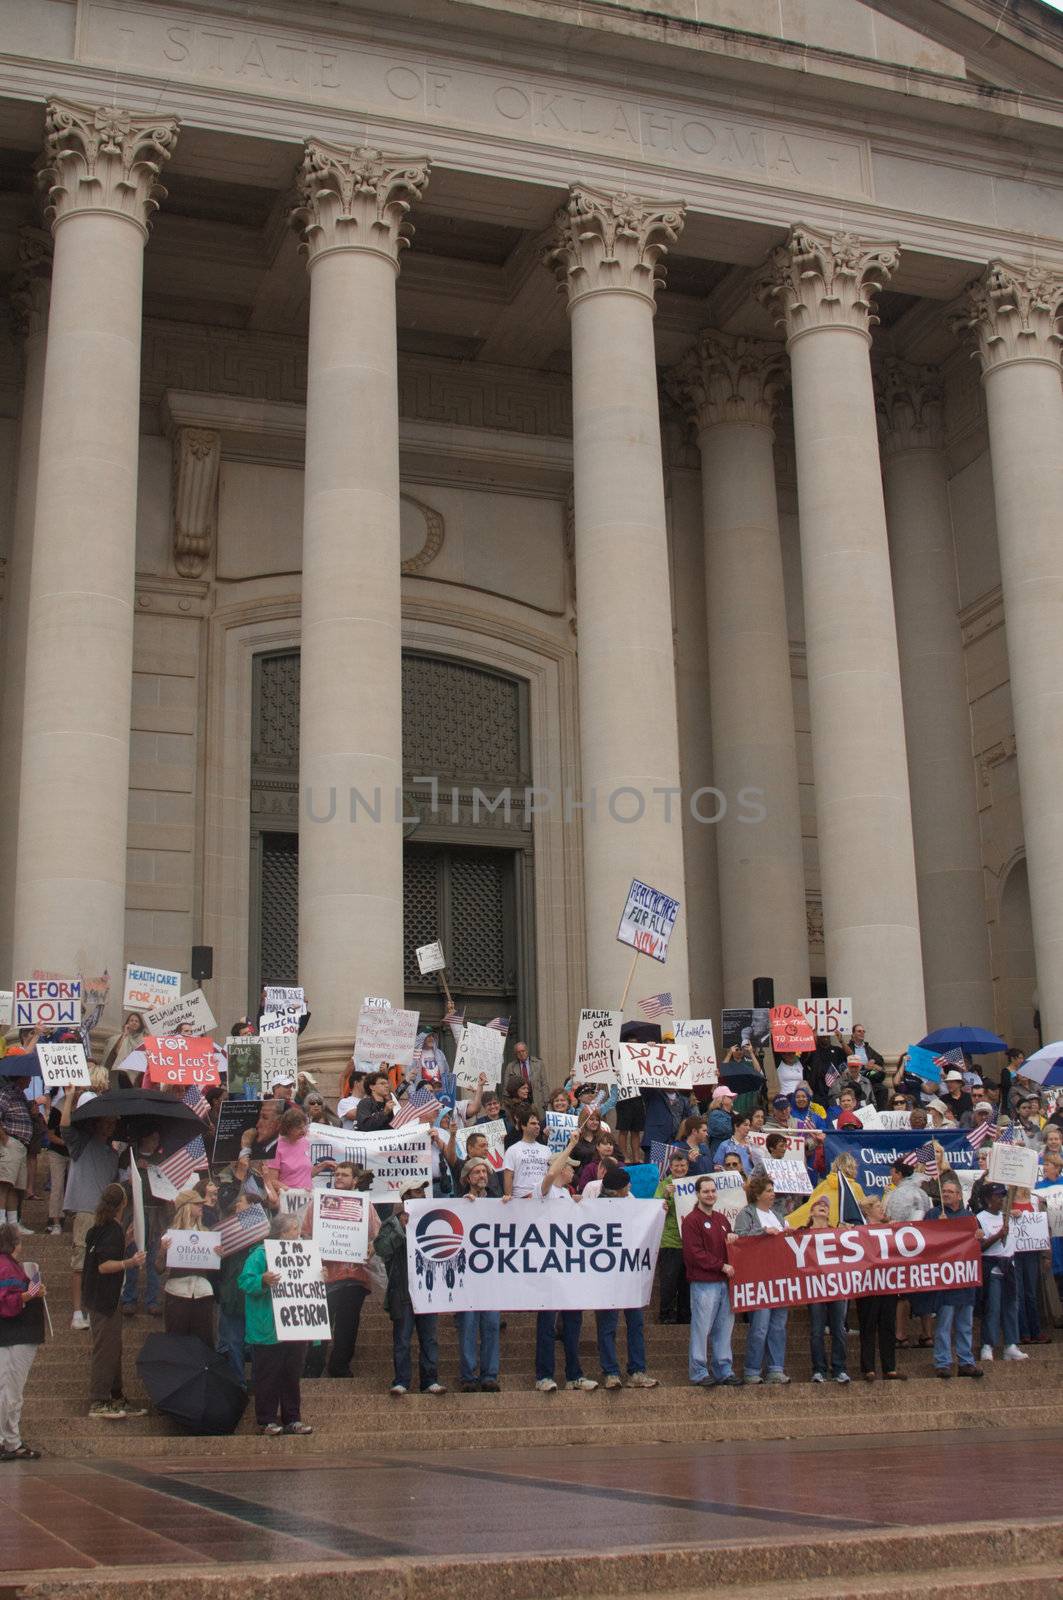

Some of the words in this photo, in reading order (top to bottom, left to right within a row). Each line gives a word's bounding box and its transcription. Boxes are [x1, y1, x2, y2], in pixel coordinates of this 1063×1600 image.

[162, 26, 342, 90] STATE
[384, 65, 452, 110] OF
[492, 84, 802, 176] OKLAHOMA
[628, 906, 649, 926] FOR
[648, 914, 666, 936] ALL
[128, 969, 156, 982] HEALTH
[156, 973, 178, 987] CARE
[16, 982, 81, 999] REFORM
[128, 990, 150, 1003] FOR
[186, 997, 200, 1008] THE
[368, 997, 388, 1008] FOR
[17, 1002, 75, 1024] NOW
[276, 1006, 296, 1019] NO
[582, 1011, 609, 1020] HEALTH
[774, 1006, 802, 1018] NOW
[260, 1016, 299, 1033] TRICKL
[592, 1018, 613, 1029] CARE
[587, 1031, 593, 1039] IS
[600, 1030, 606, 1038] A
[157, 1037, 188, 1050] FOR
[582, 1038, 611, 1050] BASIC
[269, 1046, 291, 1057] THE
[579, 1049, 606, 1063] HUMAN
[44, 1053, 79, 1066] PUBLIC
[688, 1055, 715, 1064] ASIC
[48, 1067, 84, 1080] OPTION
[167, 1069, 186, 1083] OF
[193, 1069, 216, 1082] US
[549, 1129, 571, 1143] CAR
[379, 1142, 427, 1152] HEALTH
[387, 1155, 418, 1164] CARE
[377, 1167, 429, 1178] REFORM
[469, 1223, 622, 1248] CHANGE
[177, 1245, 211, 1255] OBAMA
[279, 1242, 304, 1255] I'M
[785, 1230, 865, 1268] YES
[868, 1226, 926, 1260] TO
[275, 1255, 312, 1267] READY
[468, 1248, 651, 1273] OKLAHOMA
[271, 1281, 327, 1300] HEALTHCARE
[733, 1277, 802, 1308] HEALTH
[804, 1265, 907, 1299] INSURANCE
[909, 1260, 978, 1288] REFORM
[280, 1303, 328, 1328] REFORM
